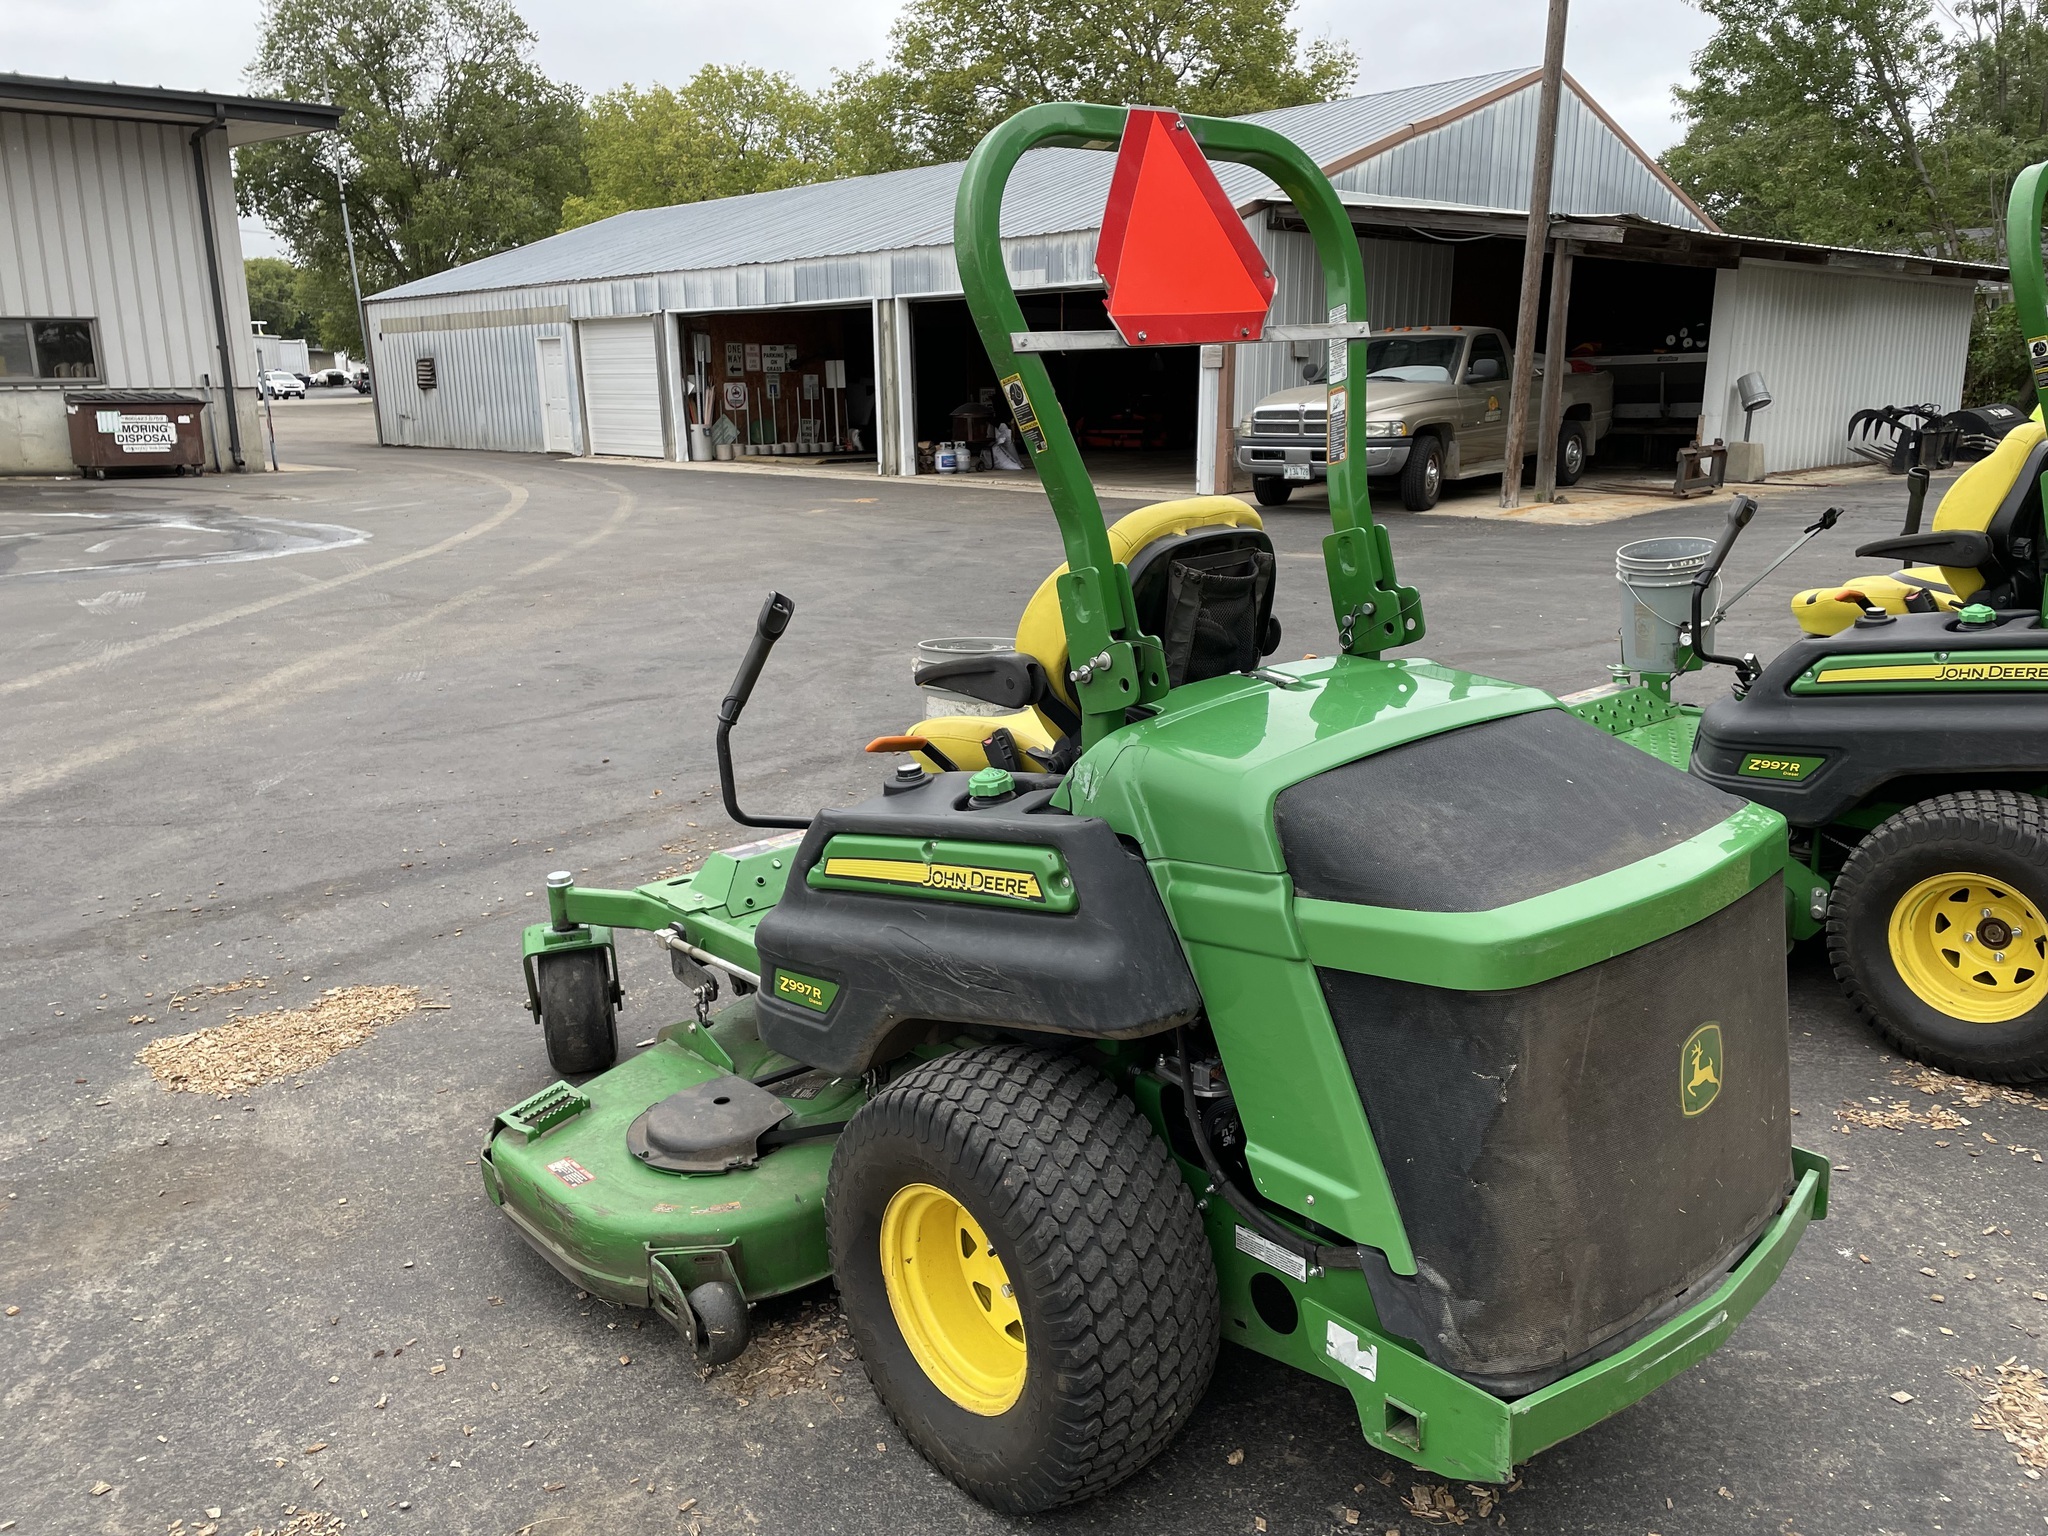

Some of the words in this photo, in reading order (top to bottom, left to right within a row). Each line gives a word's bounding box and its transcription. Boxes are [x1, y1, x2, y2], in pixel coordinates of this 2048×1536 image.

[727, 345, 741, 354] ONE
[727, 355, 742, 363] WAY
[121, 425, 168, 433] MORING
[117, 434, 174, 443] DISPOSAL
[1934, 665, 1985, 681] JOHN
[1988, 665, 2048, 679] DEERE
[1748, 758, 1801, 773] Z997R
[923, 866, 967, 888] JOHN
[971, 871, 1029, 896] DEERE
[780, 976, 821, 999] Z997R
[808, 998, 823, 1006] Diesel
